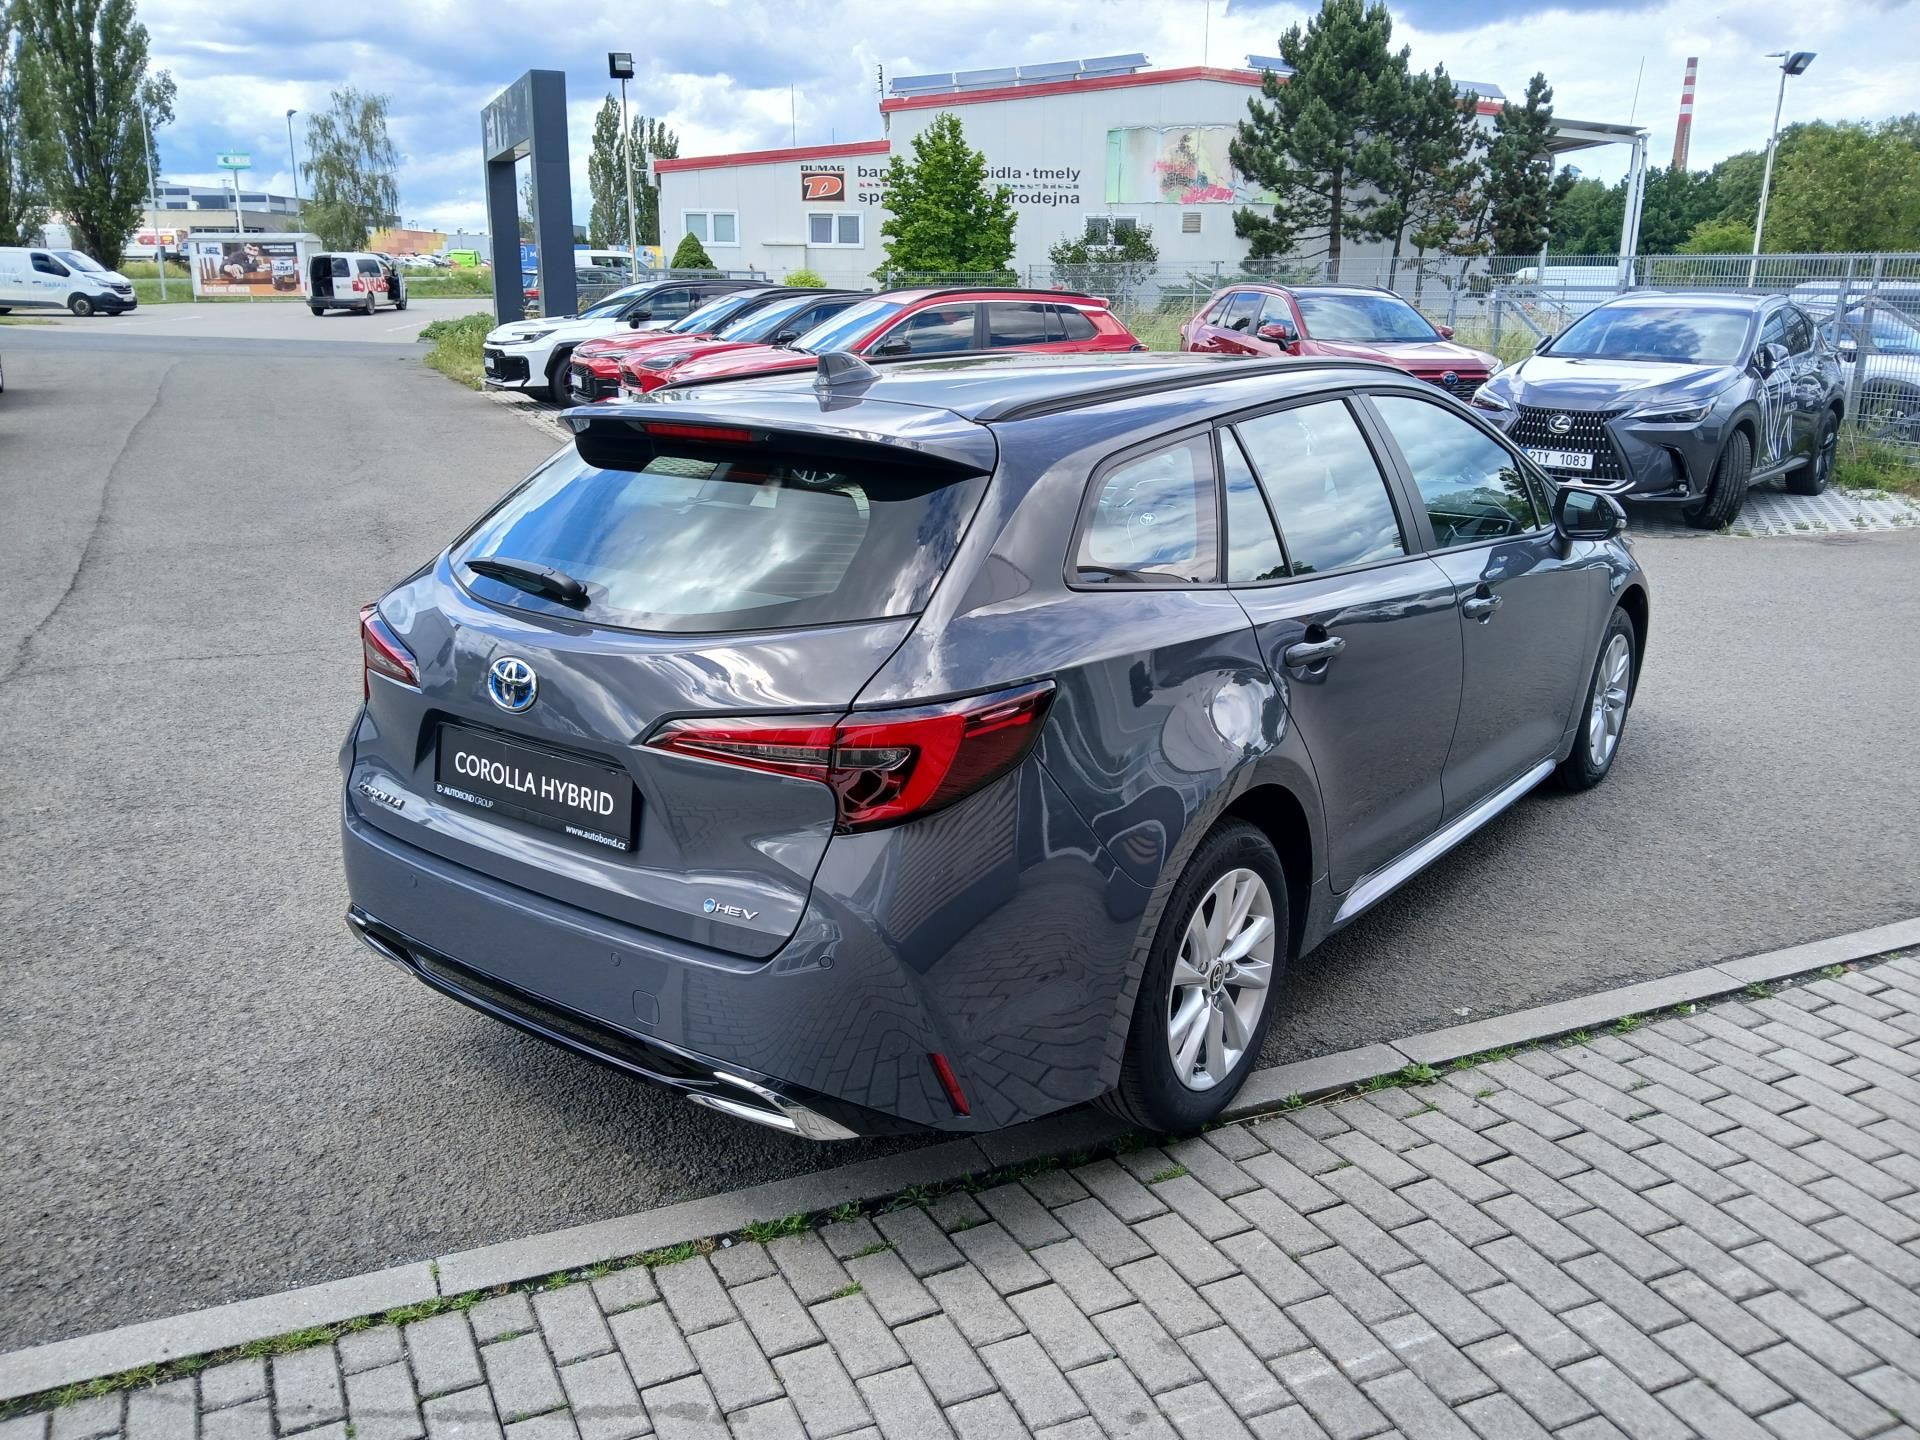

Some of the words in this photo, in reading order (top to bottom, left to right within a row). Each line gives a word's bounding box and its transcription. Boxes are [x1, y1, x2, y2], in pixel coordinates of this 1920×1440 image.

[1033, 167, 1080, 182] tmely
[1529, 450, 1550, 464] 2TY
[1560, 454, 1588, 467] 1083
[455, 751, 537, 795] COROLLA
[541, 775, 614, 816] HYBRID
[443, 786, 475, 803] AUTOBOND
[475, 796, 494, 808] GROUP
[565, 825, 627, 851] www.autobond.cz
[715, 903, 759, 920] HEV
